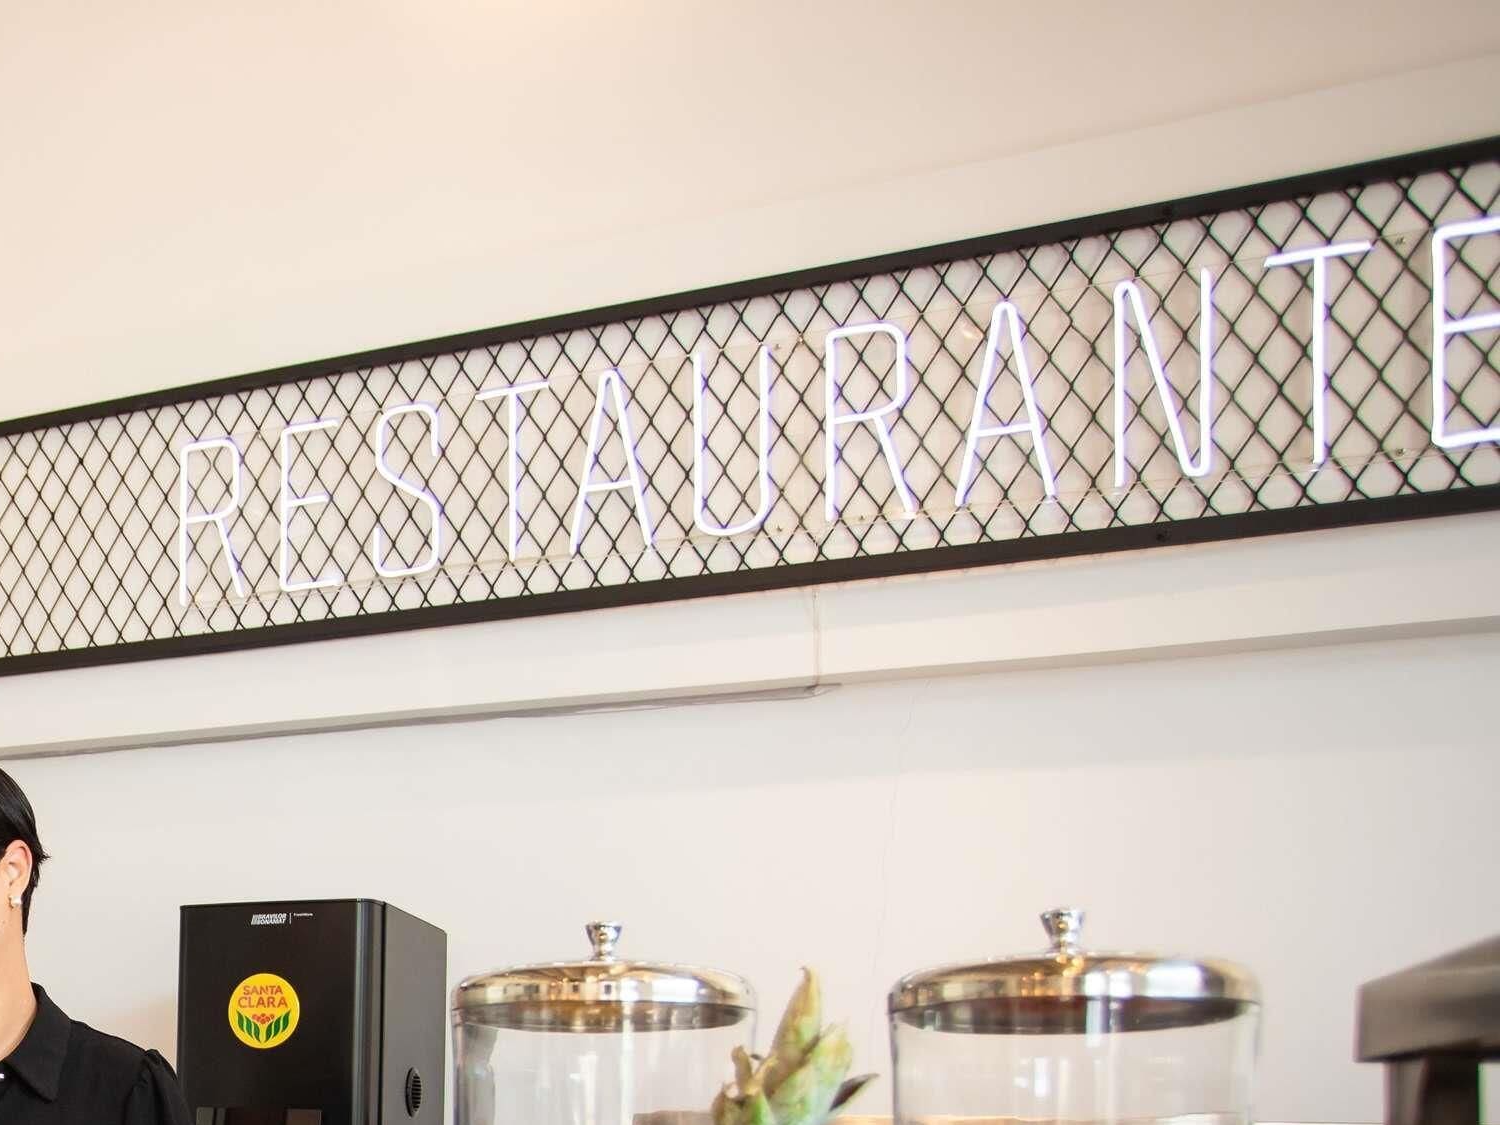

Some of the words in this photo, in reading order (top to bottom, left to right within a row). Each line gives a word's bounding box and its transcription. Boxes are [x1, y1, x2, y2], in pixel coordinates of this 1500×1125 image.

[179, 214, 1500, 607] RESTAURANTE
[242, 984, 283, 995] SANTA
[238, 996, 288, 1009] CLARA
